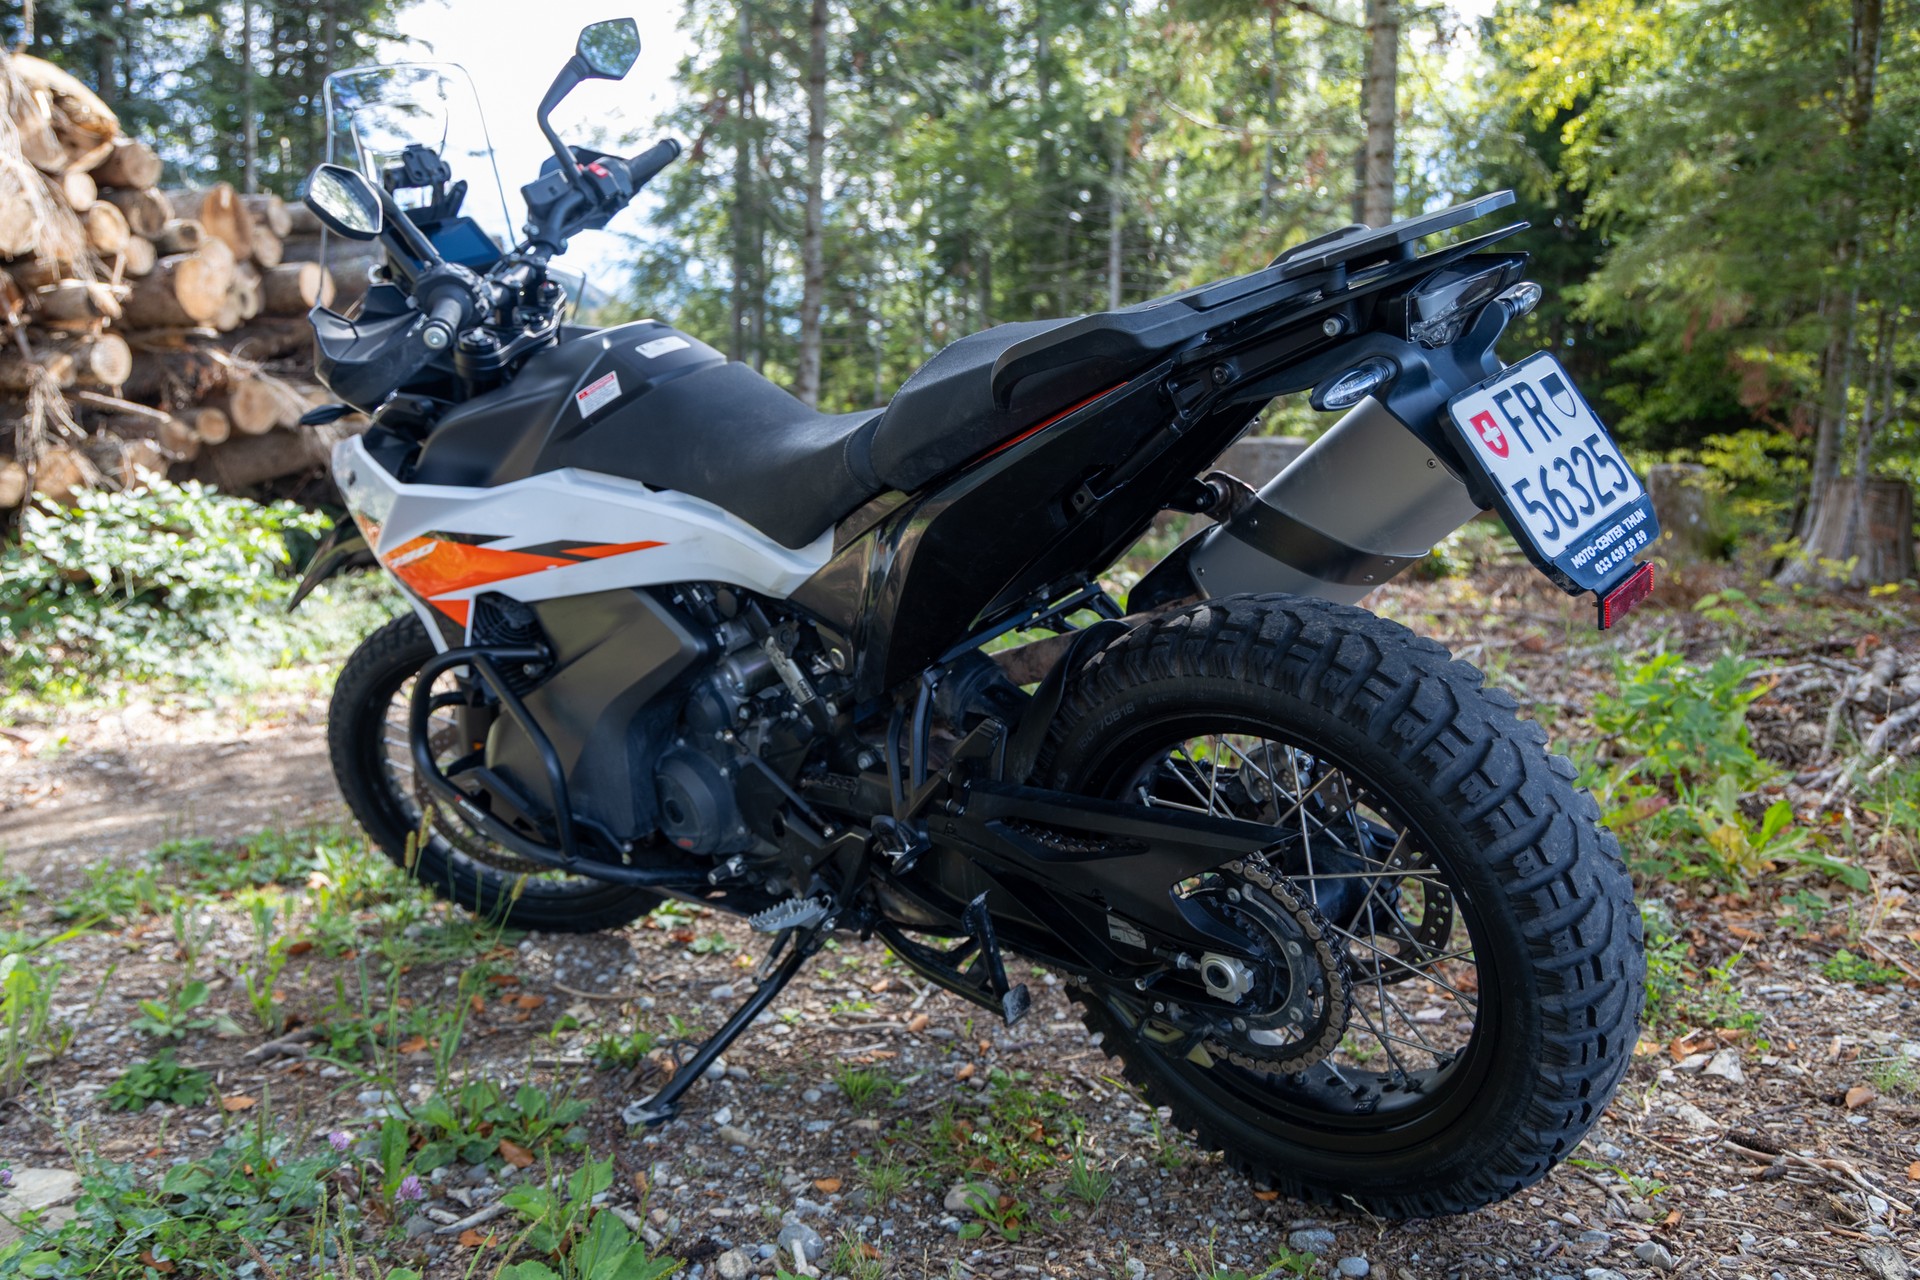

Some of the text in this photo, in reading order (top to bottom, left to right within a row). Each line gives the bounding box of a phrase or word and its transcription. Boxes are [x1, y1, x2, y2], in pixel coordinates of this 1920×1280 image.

[1493, 381, 1562, 454] FR
[1511, 433, 1629, 541] 56325
[1570, 508, 1647, 569] MOTO-CENTER THUN
[1594, 530, 1647, 575] 033 439 59 59
